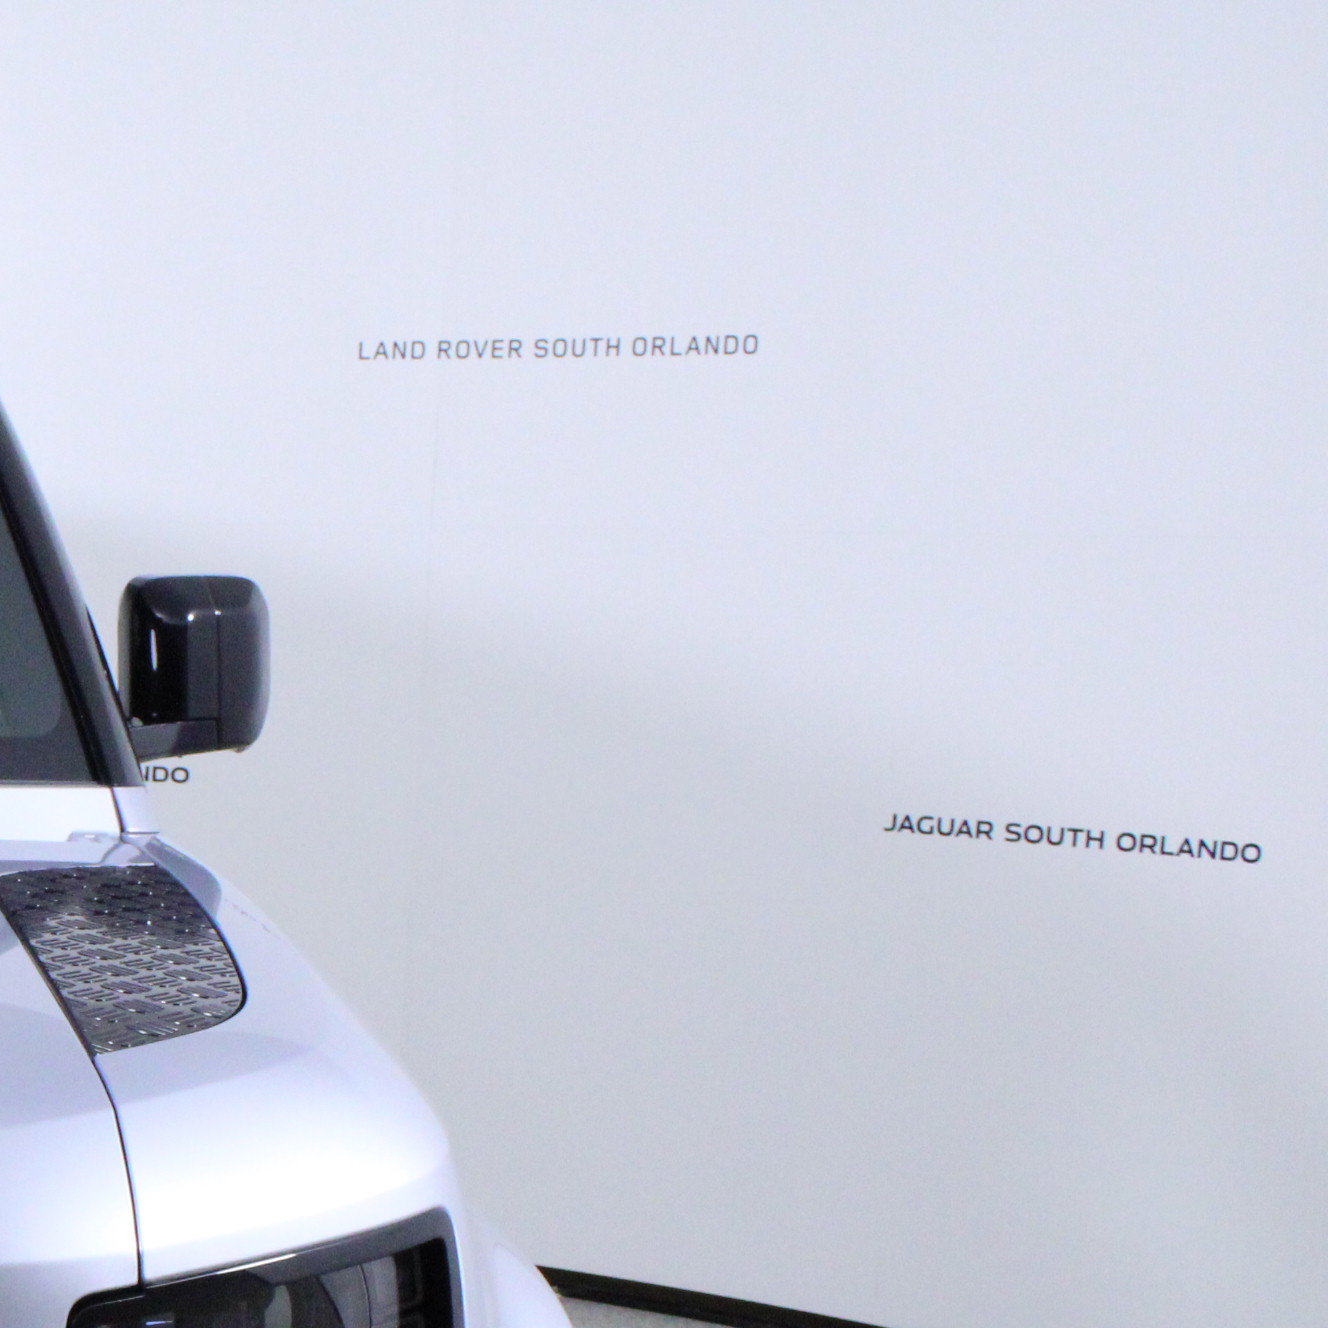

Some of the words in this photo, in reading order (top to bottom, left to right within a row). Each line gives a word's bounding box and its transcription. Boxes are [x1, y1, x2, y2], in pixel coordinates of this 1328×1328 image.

[358, 340, 426, 361] LAND
[437, 338, 523, 360] ROVER
[534, 336, 621, 359] SOUTH
[632, 333, 759, 358] ORLANDO
[883, 812, 995, 841] JAGUAR
[1004, 822, 1106, 851] SOUTH
[1116, 831, 1263, 865] ORLANDO
